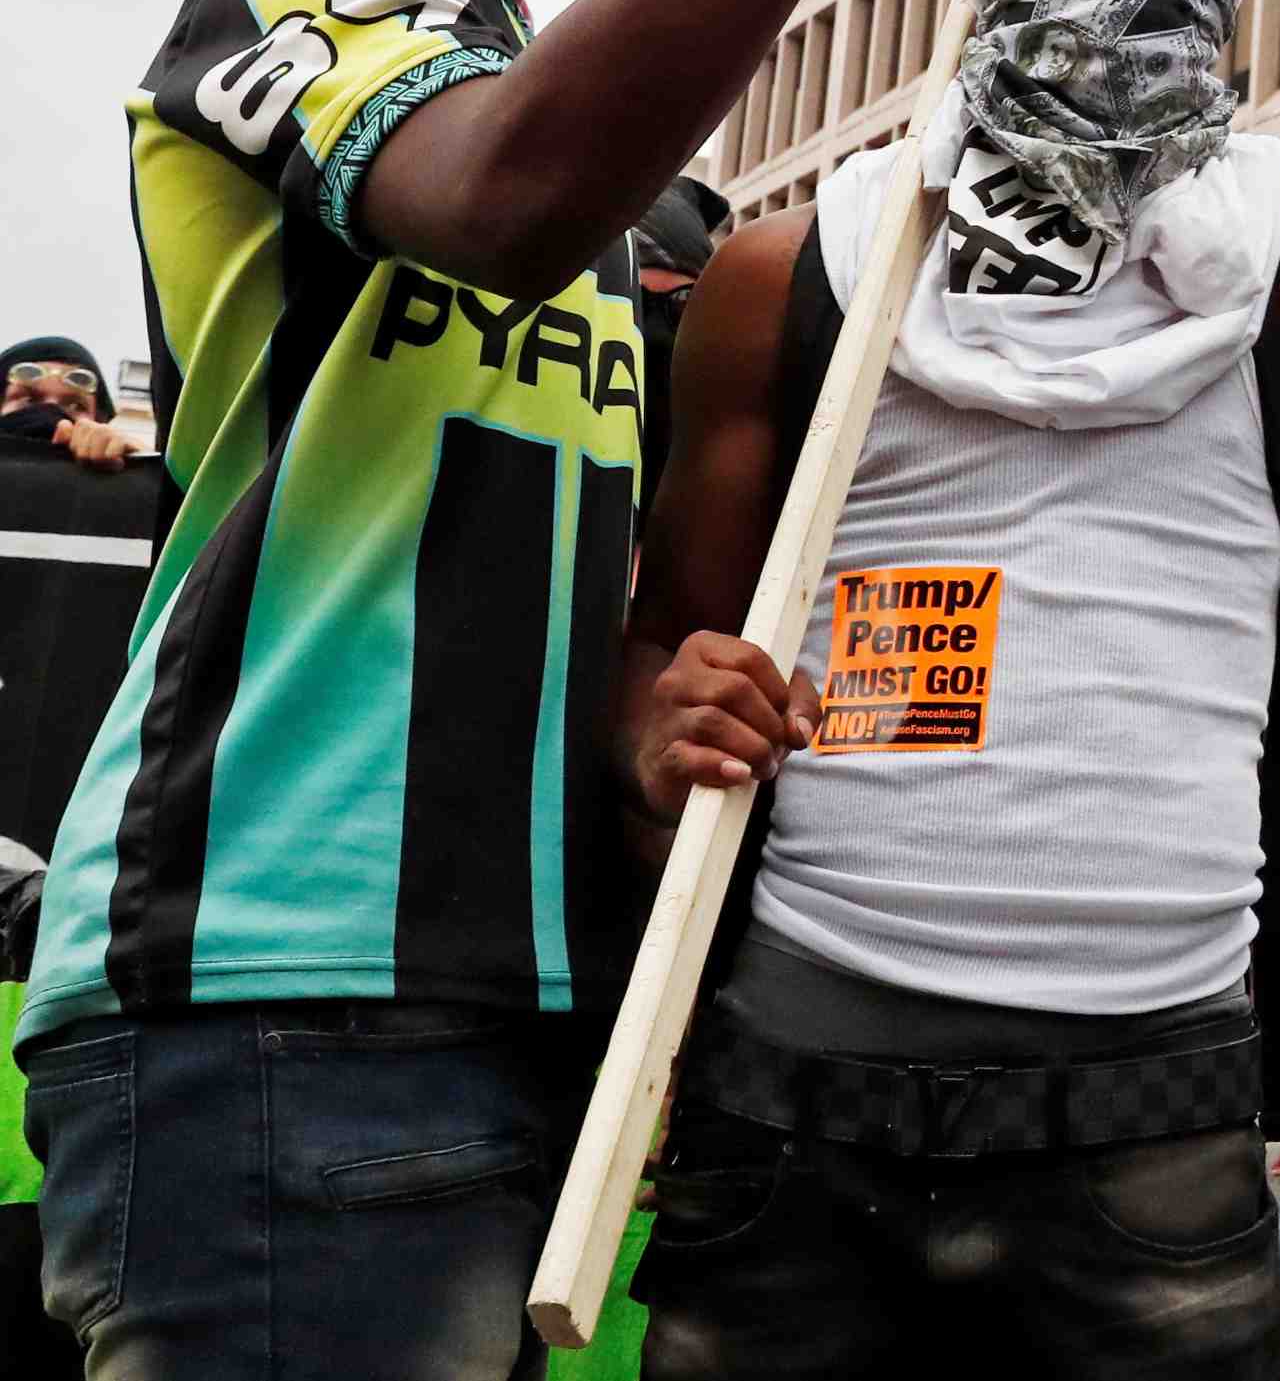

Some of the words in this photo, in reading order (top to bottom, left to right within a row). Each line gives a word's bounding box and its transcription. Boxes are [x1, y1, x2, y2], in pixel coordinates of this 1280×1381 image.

[841, 571, 998, 617] Trump/
[846, 619, 978, 657] Pence
[827, 665, 918, 699] MUST
[925, 664, 987, 696] GO!
[823, 710, 878, 740] NO!
